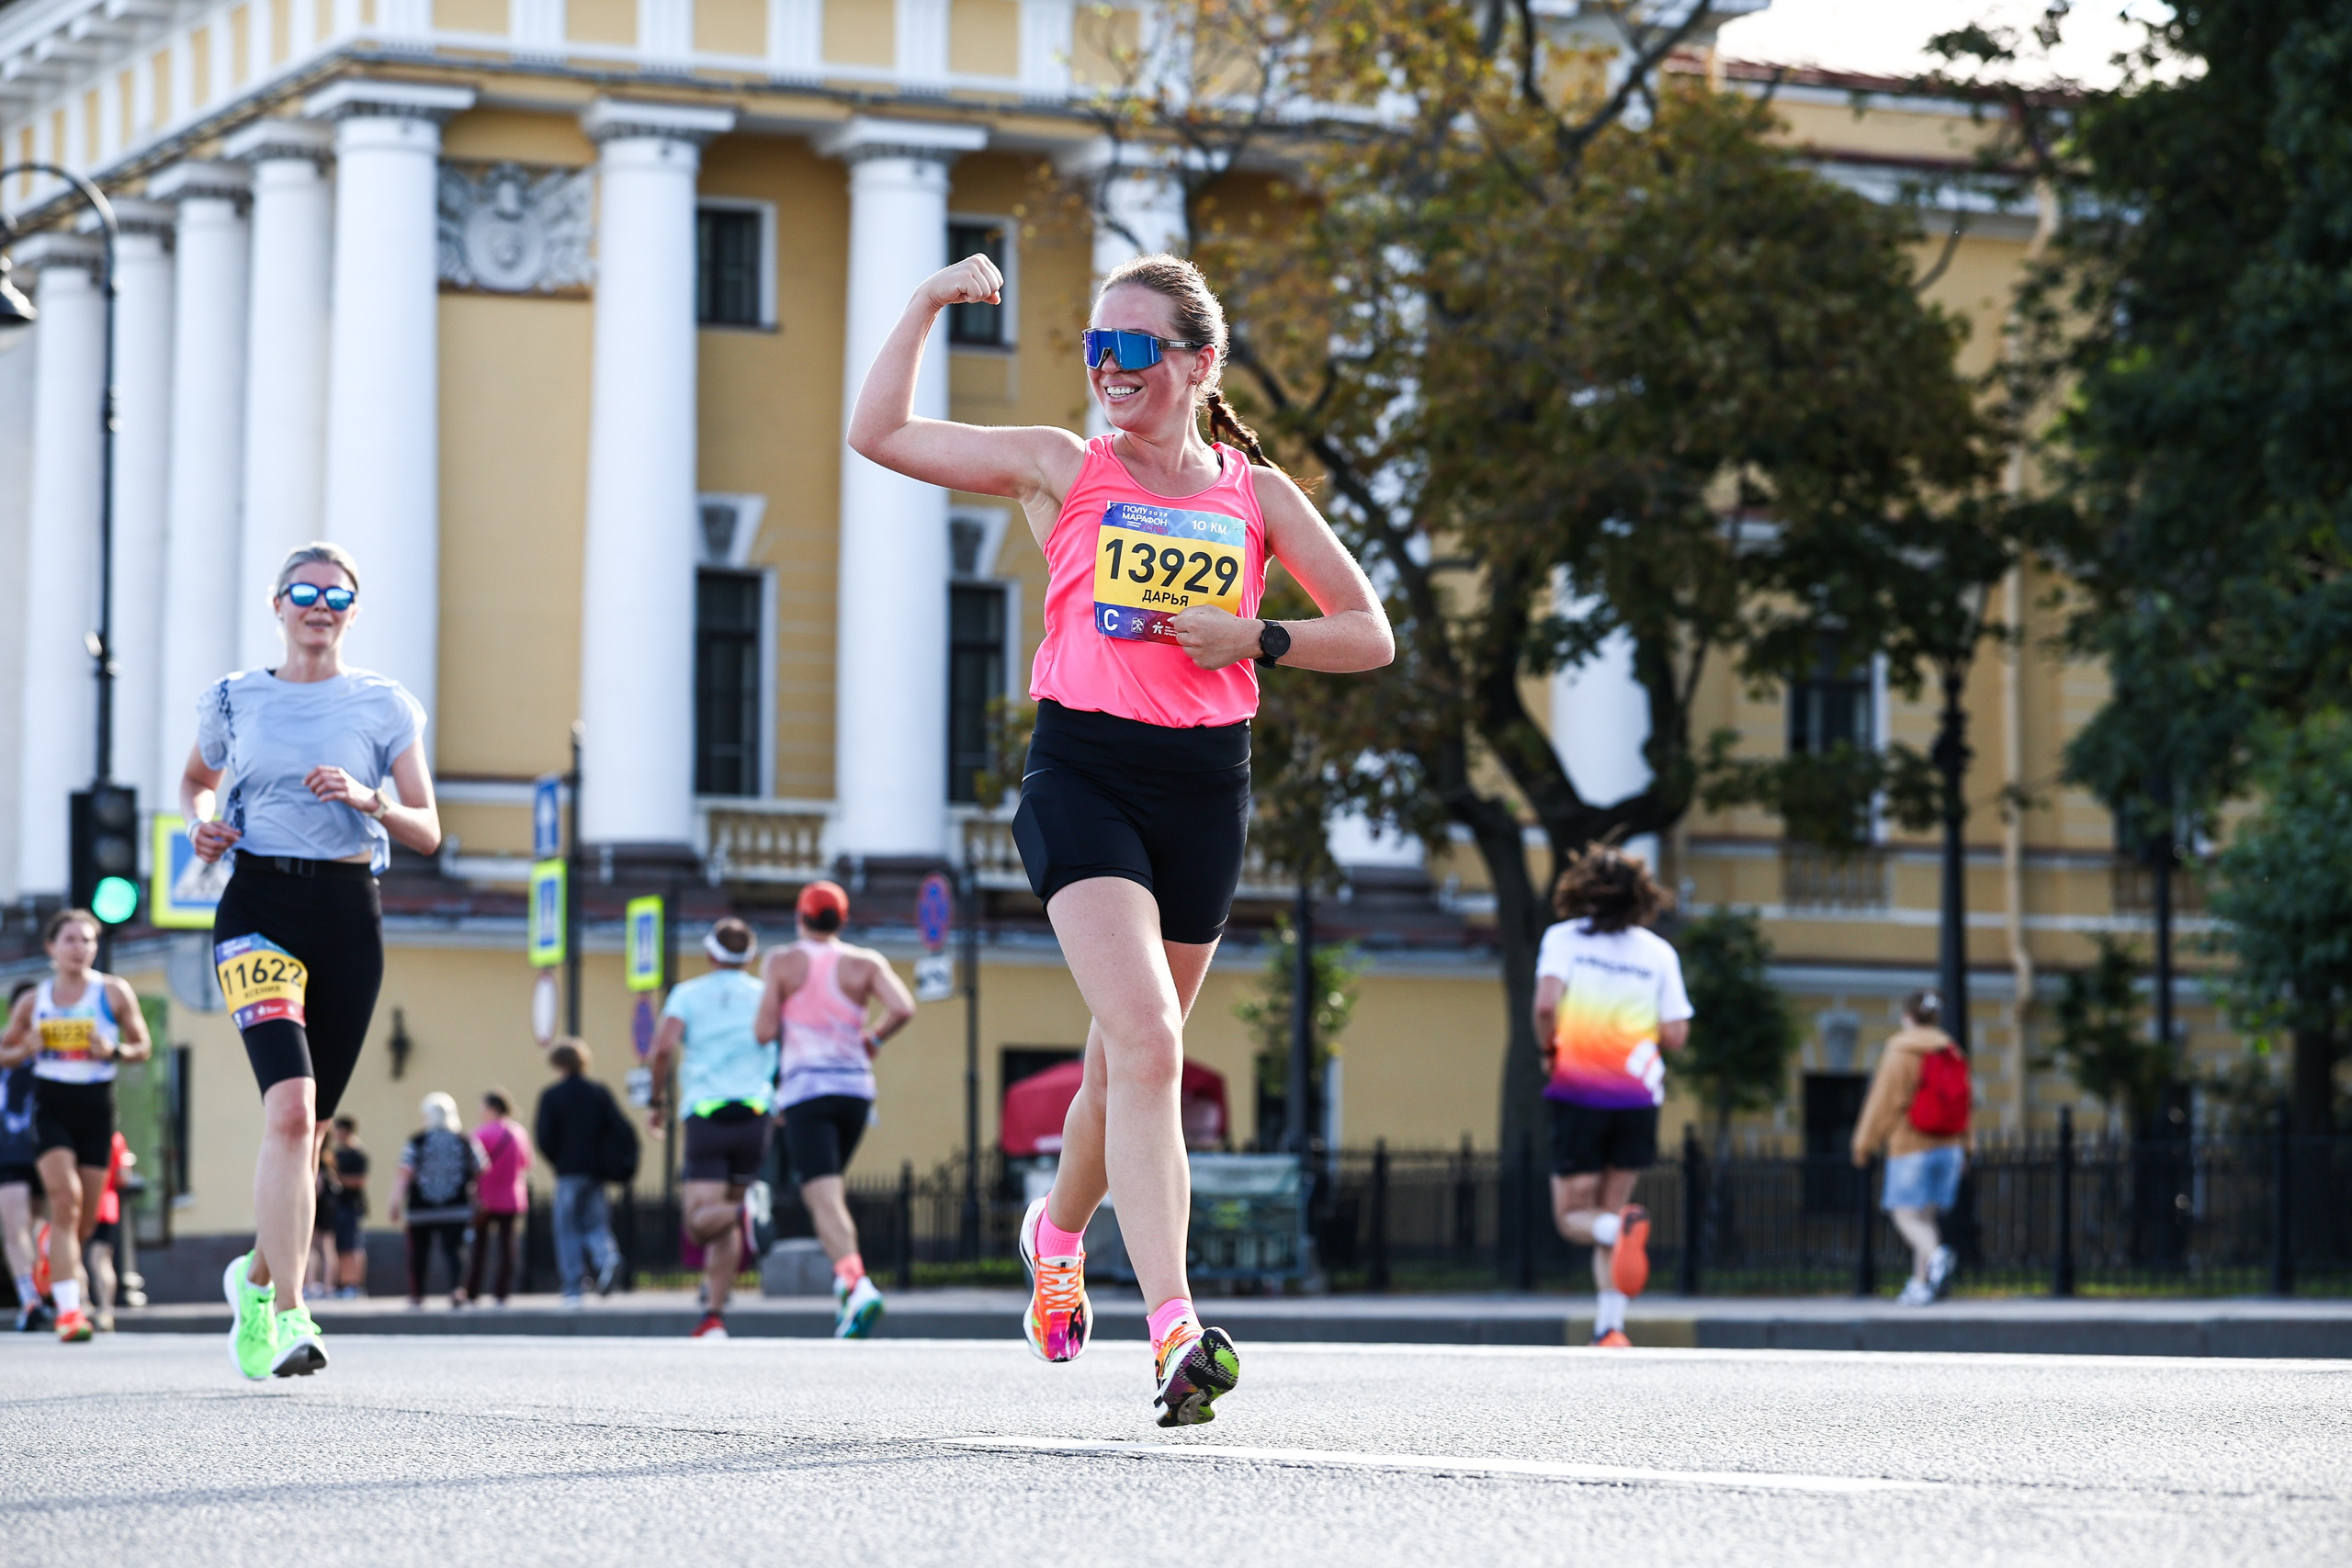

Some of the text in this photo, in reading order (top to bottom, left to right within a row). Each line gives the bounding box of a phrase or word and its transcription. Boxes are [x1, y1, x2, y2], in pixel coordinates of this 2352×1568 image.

[1123, 505, 1148, 514] ПОЛУ
[1122, 512, 1168, 526] МАРАФОН
[1192, 520, 1227, 535] 10 КМ
[1105, 538, 1238, 597] 13929
[1141, 589, 1189, 607] ДАРЬЯ
[223, 958, 302, 996] 11622
